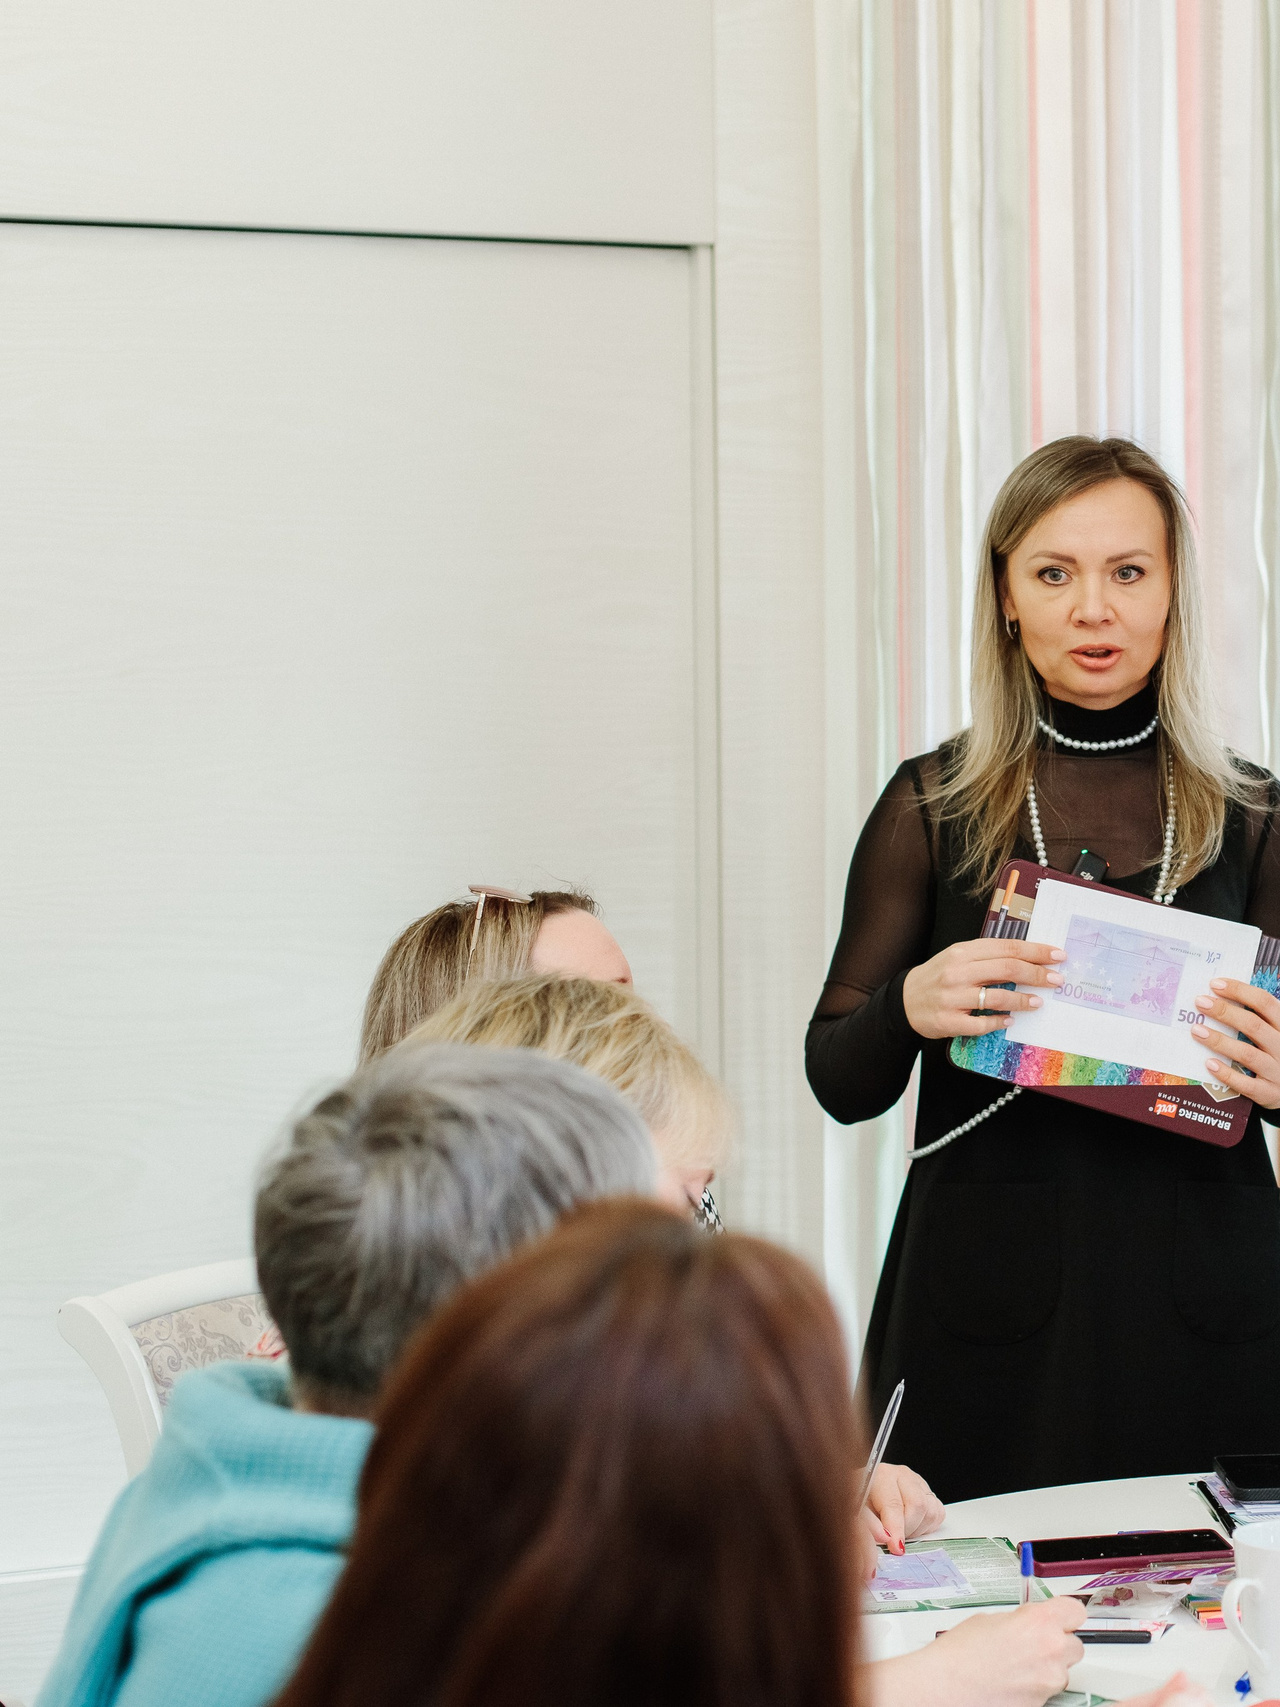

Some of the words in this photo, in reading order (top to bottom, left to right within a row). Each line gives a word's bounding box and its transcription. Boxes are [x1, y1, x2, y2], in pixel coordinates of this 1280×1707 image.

[1178, 1009, 1205, 1025] 500
[1157, 1092, 1181, 1103] СЕРИЯ
[1156, 1103, 1177, 1116] art
[1183, 1100, 1234, 1119] ПРЕМИАЛЬНАЯ
[1178, 1108, 1231, 1131] BRAUBERG
